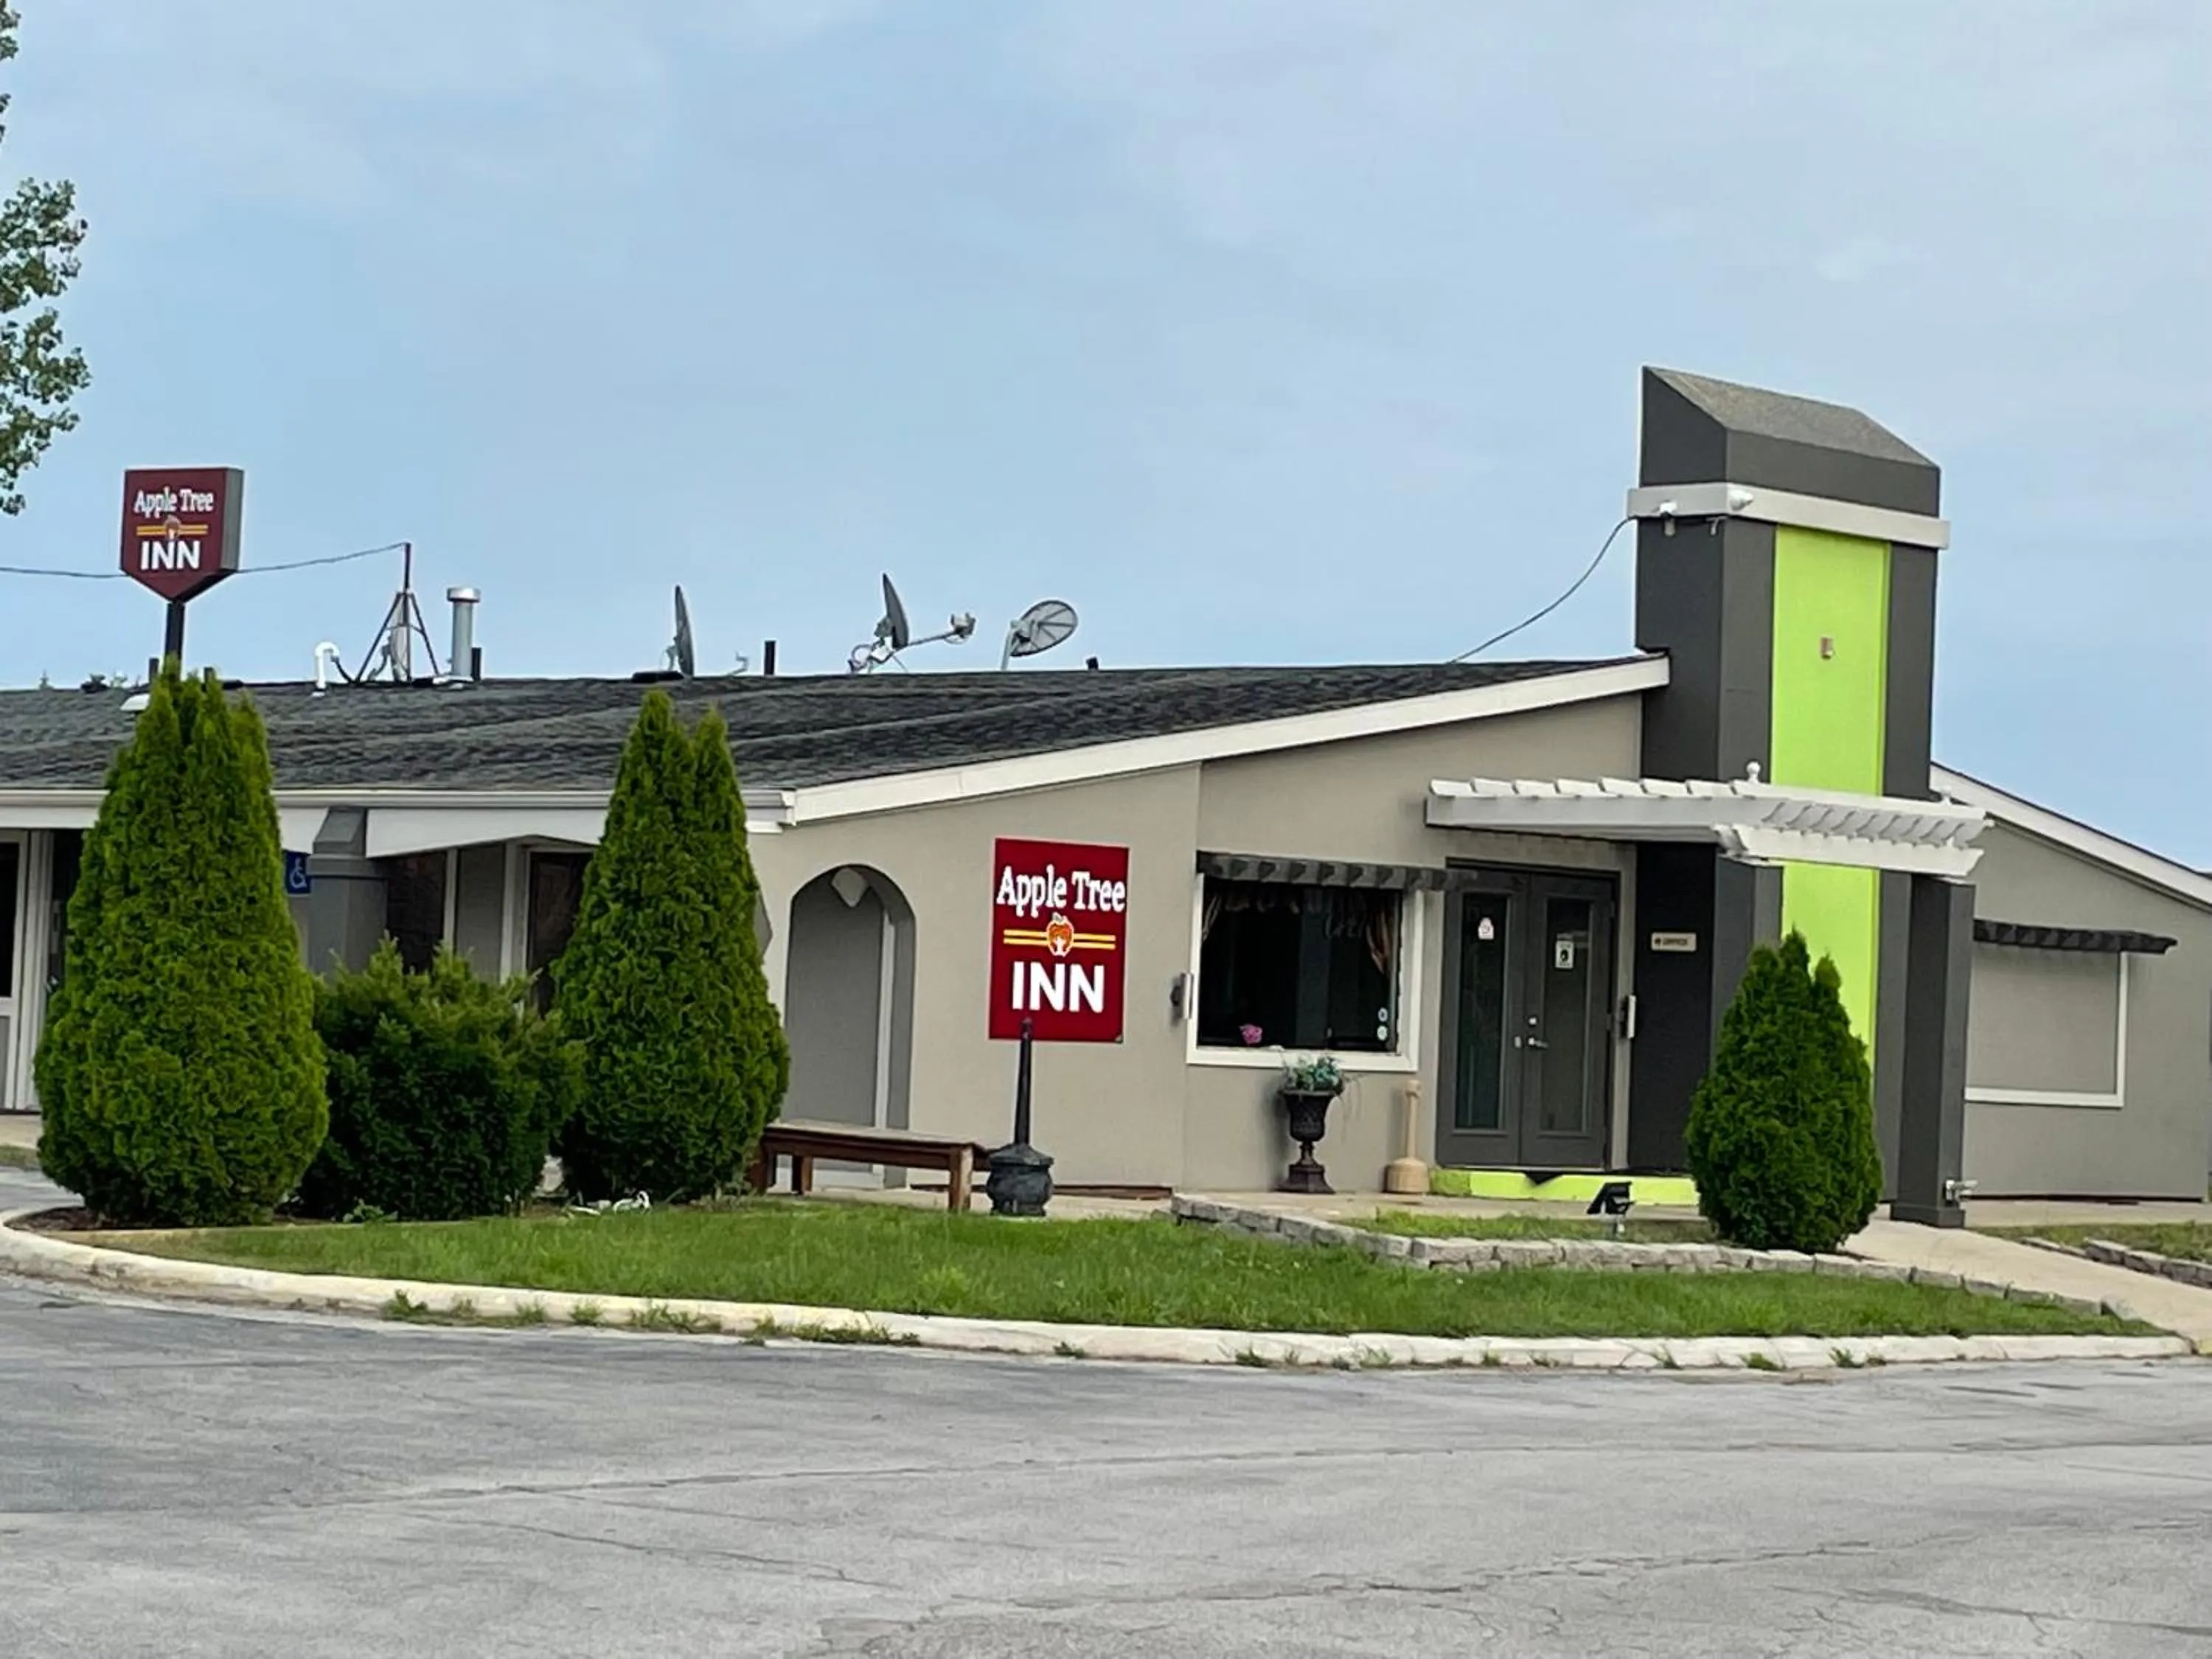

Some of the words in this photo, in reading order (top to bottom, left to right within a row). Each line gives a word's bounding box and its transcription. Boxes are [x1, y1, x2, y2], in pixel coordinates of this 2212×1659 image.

[133, 487, 178, 518] Apple
[180, 488, 214, 512] Tree
[141, 540, 201, 570] INN
[996, 863, 1067, 918] Apple
[1071, 870, 1126, 912] Tree
[1012, 961, 1105, 1013] INN
